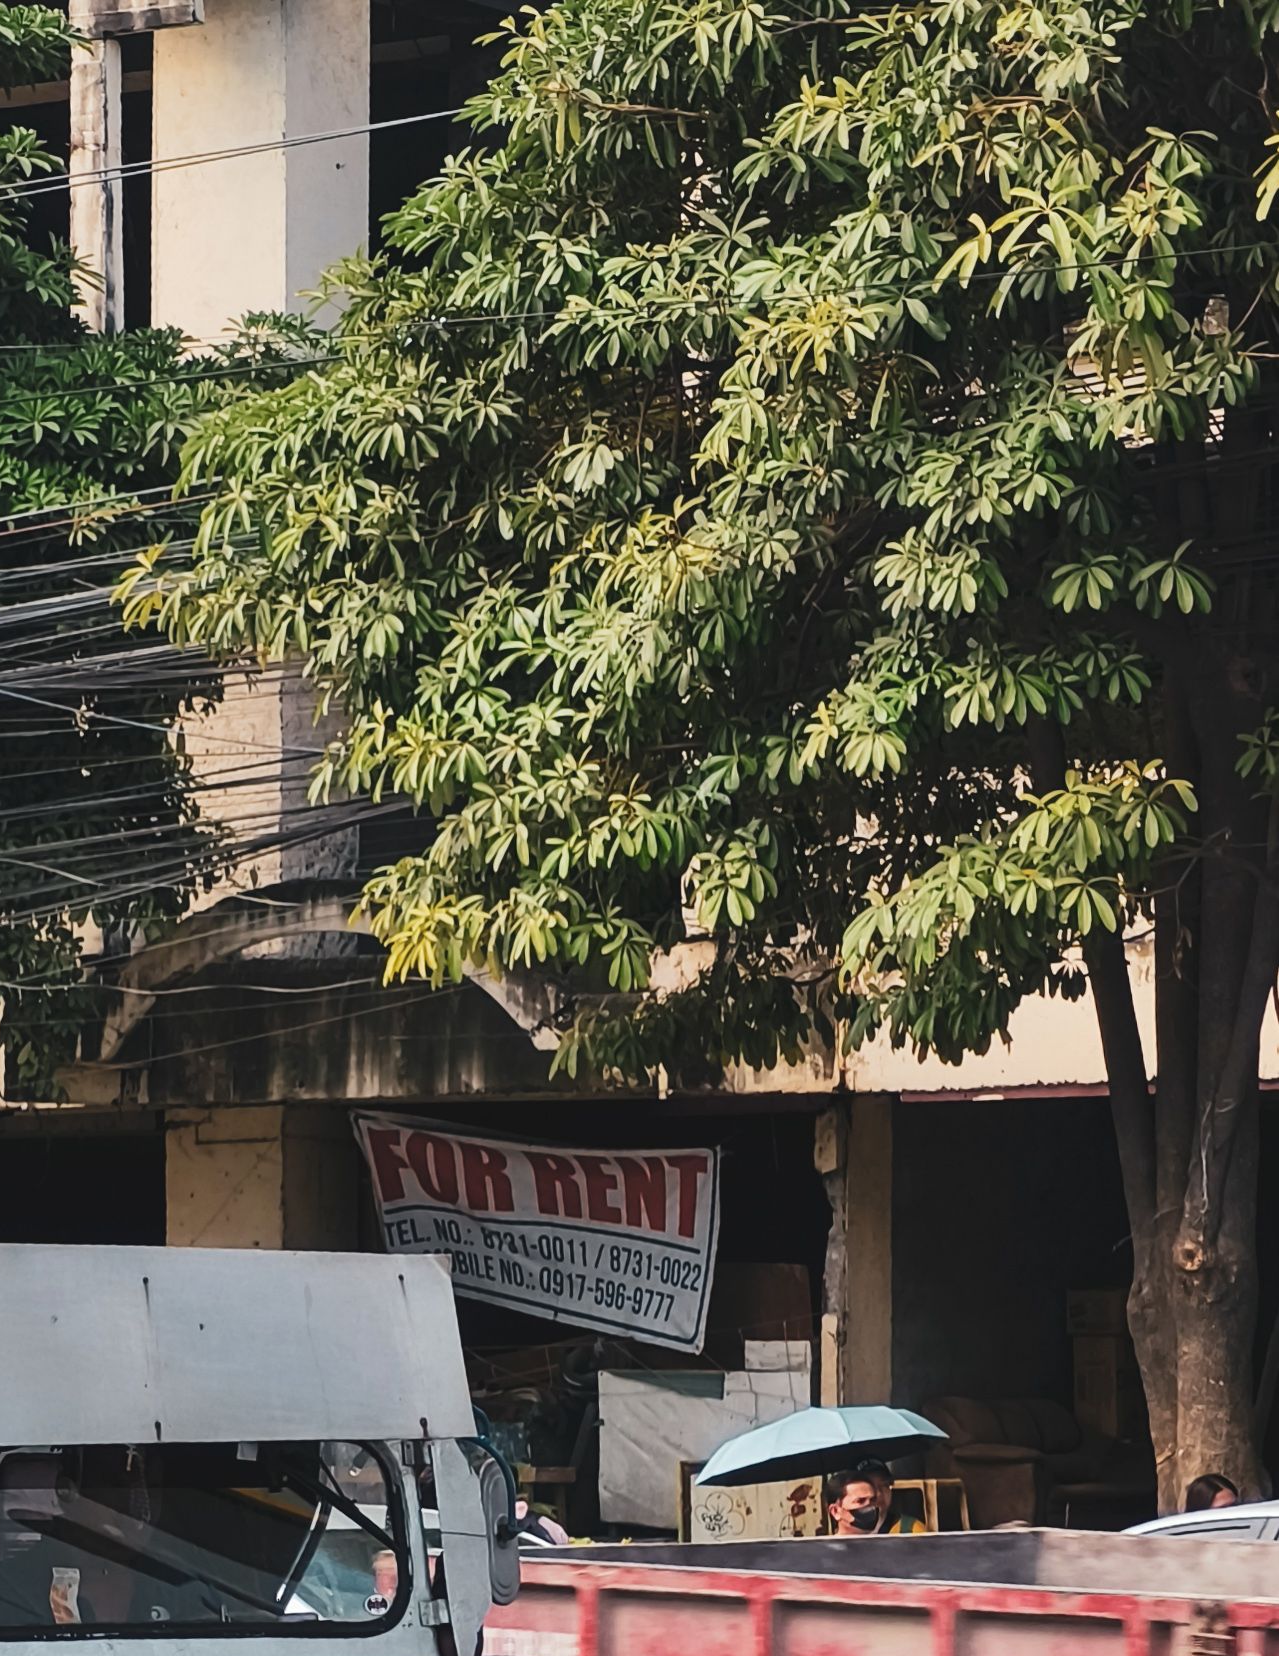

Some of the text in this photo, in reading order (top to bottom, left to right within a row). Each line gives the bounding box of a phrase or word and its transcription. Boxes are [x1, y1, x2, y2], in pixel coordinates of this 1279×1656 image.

[368, 1126, 709, 1241] FOR RENT
[383, 1218, 431, 1248] TEL.
[609, 1244, 703, 1293] 8731-0022
[539, 1266, 675, 1323] 0917-596-9777
